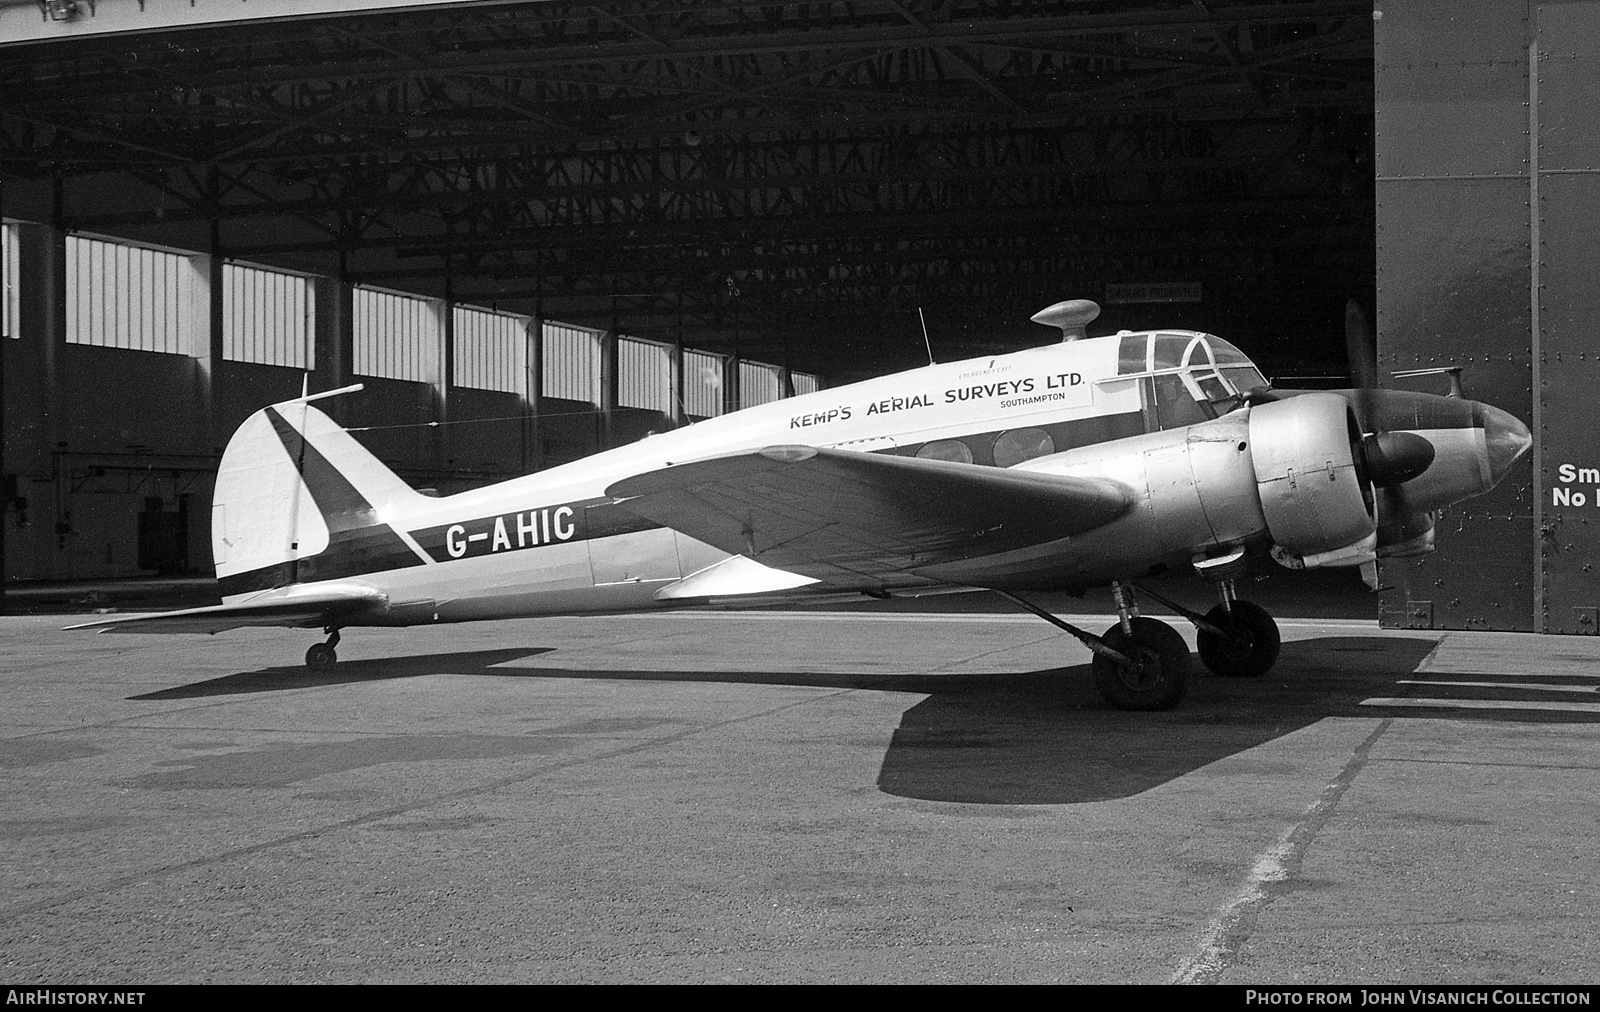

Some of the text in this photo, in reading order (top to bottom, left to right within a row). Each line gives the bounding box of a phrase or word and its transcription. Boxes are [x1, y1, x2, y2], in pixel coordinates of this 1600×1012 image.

[790, 372, 1086, 429] KEMP'S AERIAL SURVEYS LTD.
[1000, 392, 1066, 408] SOUTHAMPTON
[1552, 487, 1586, 507] No
[446, 506, 575, 558] G-AHIC
